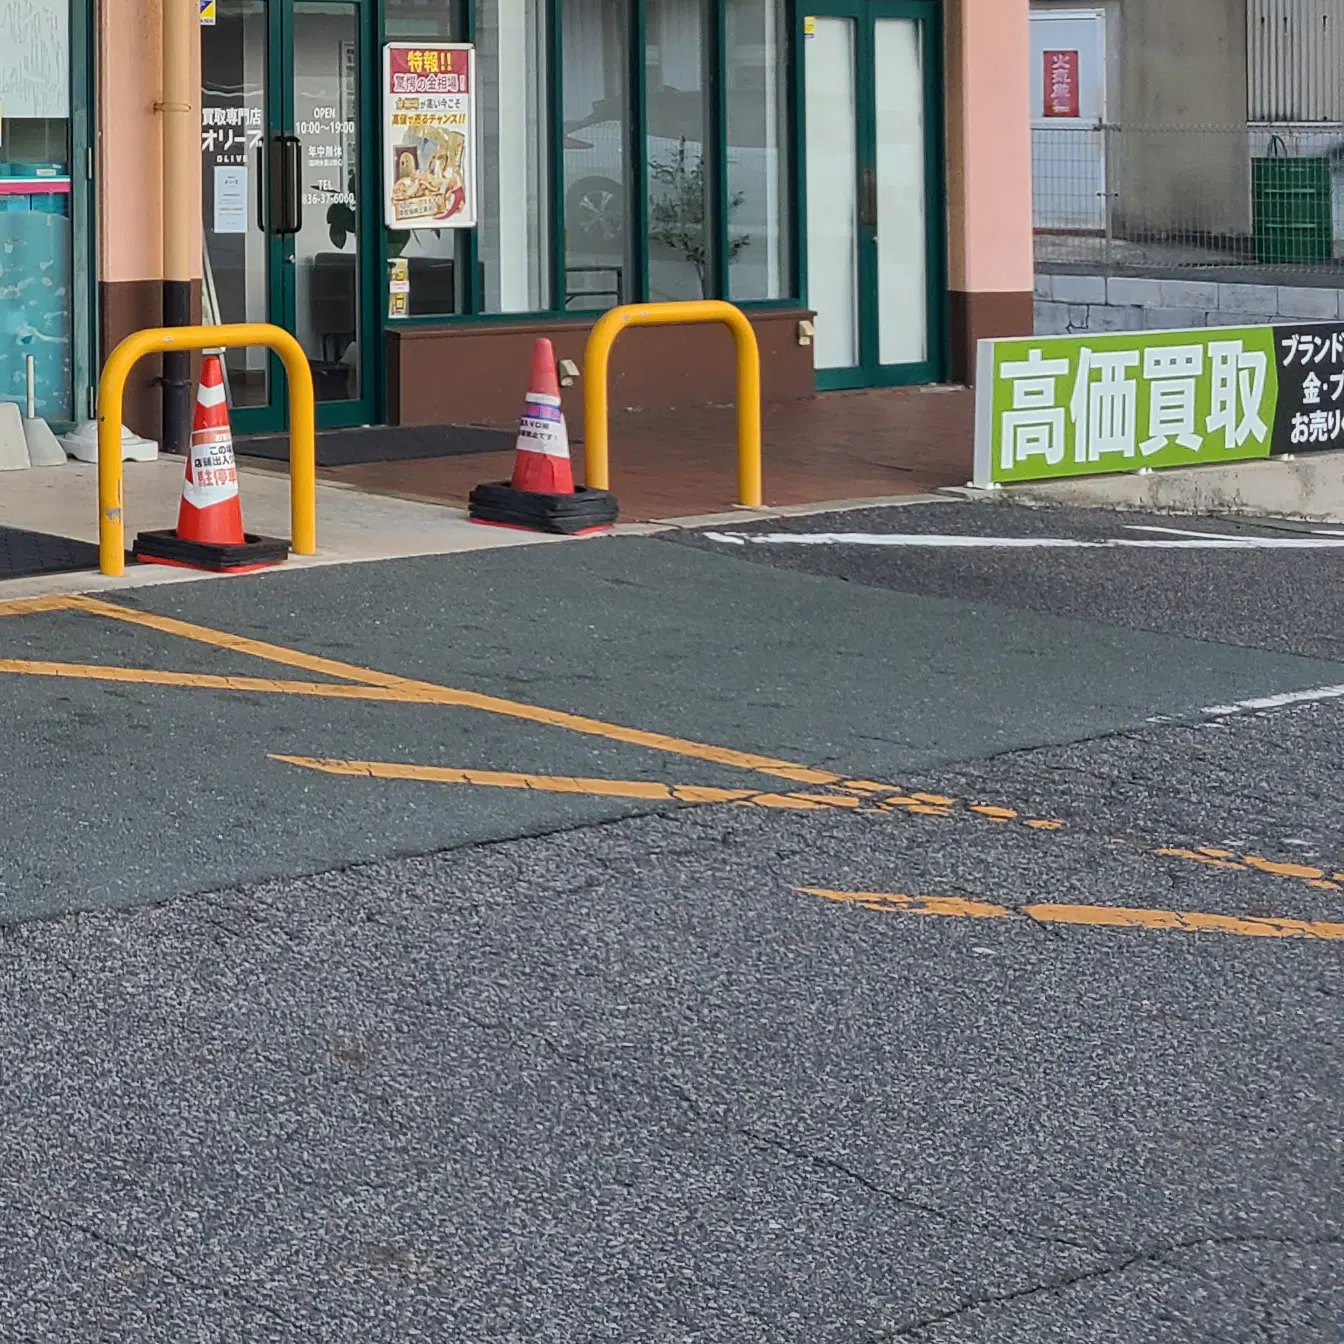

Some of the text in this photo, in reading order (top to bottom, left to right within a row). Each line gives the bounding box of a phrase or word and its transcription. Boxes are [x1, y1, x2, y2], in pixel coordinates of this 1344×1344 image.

[407, 50, 452, 73] 特報!!
[201, 107, 262, 126] 買取専門店
[313, 107, 336, 119] OPEN
[216, 154, 248, 163] OLIVE
[308, 145, 343, 158] 年中無休
[318, 179, 333, 191] TEL
[1281, 331, 1344, 367] ブランド
[999, 339, 1269, 470] 高価買取
[1290, 407, 1344, 444] お売り
